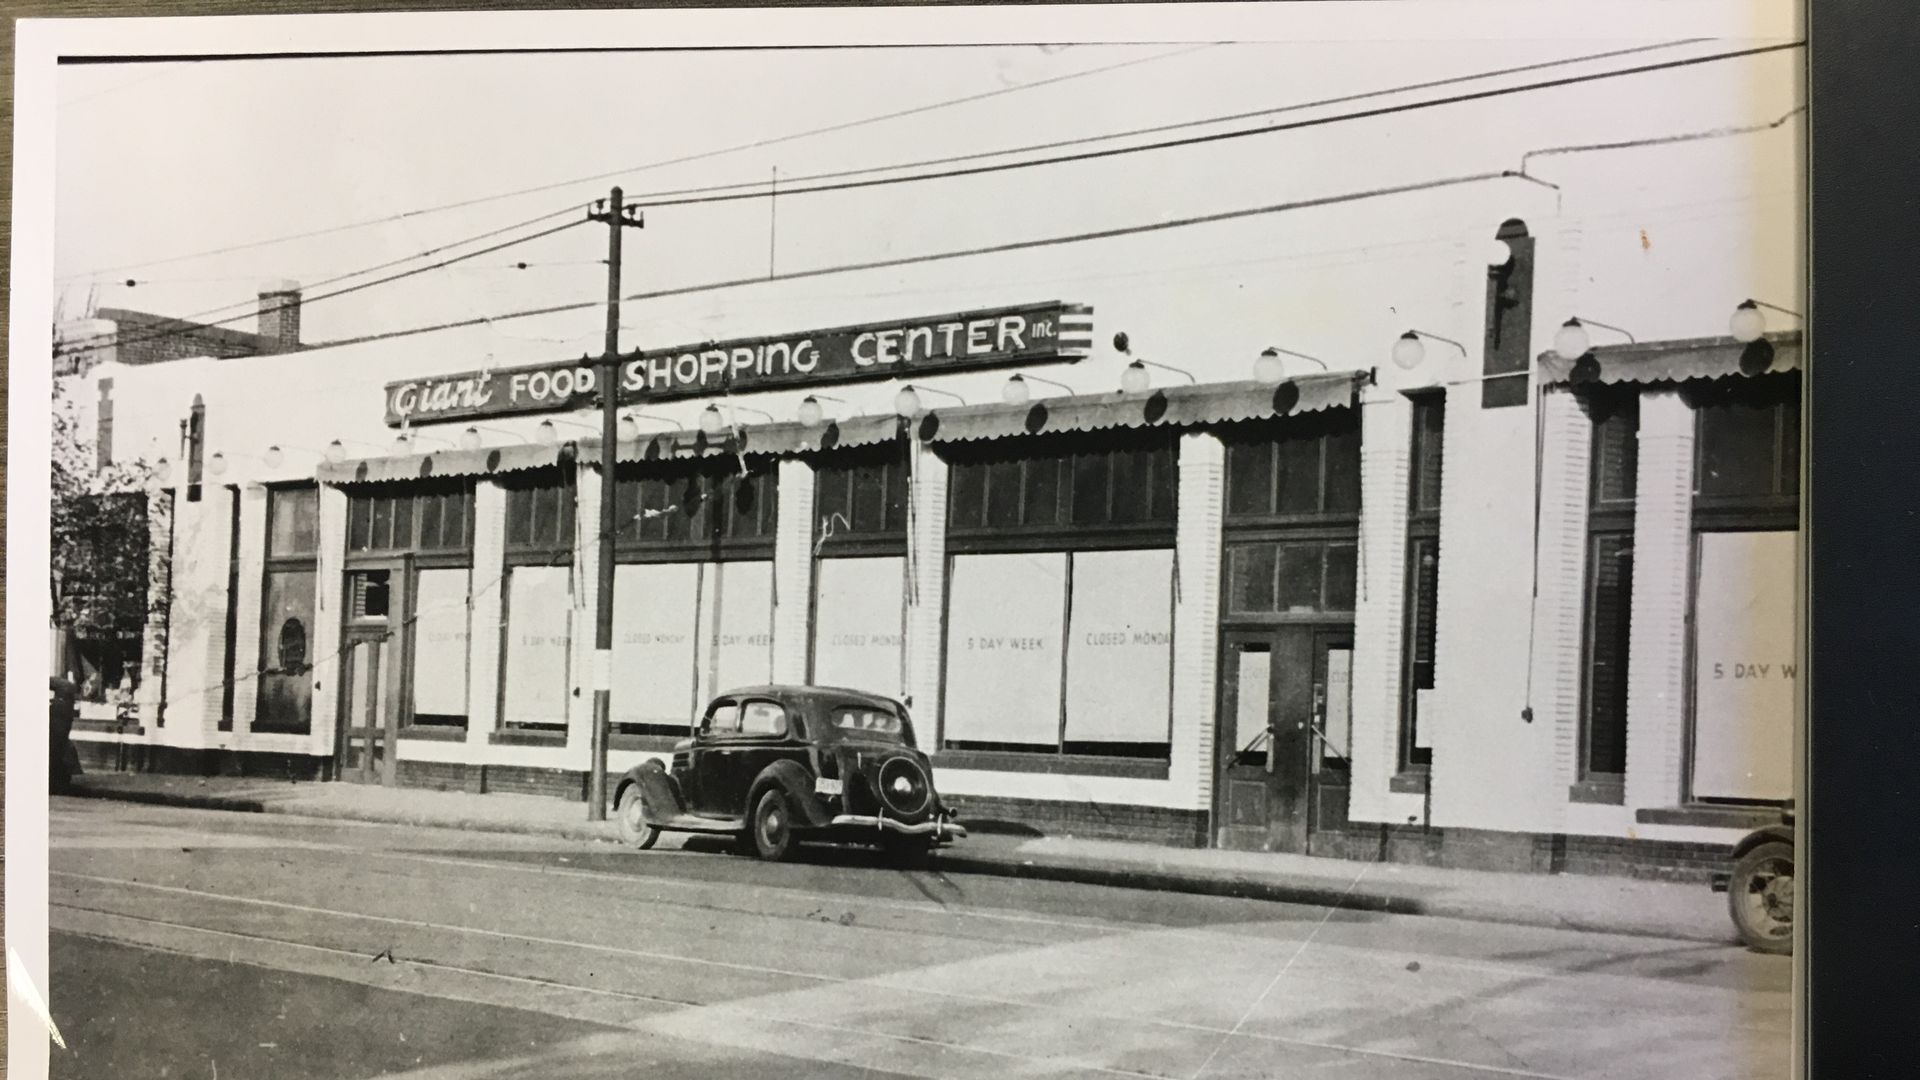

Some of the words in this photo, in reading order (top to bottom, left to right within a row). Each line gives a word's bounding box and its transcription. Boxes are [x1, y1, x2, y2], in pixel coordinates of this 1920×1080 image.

[390, 367, 493, 424] Giant
[509, 366, 596, 402] FOOD
[622, 341, 820, 392] SHOPPING
[850, 315, 1027, 366] CENTER
[967, 637, 974, 650] 5
[979, 637, 1005, 650] DAY
[1009, 637, 1045, 650] WEEK
[1086, 632, 1126, 646] CLOSED
[1713, 663, 1724, 679] 5
[1735, 663, 1770, 679] DAY
